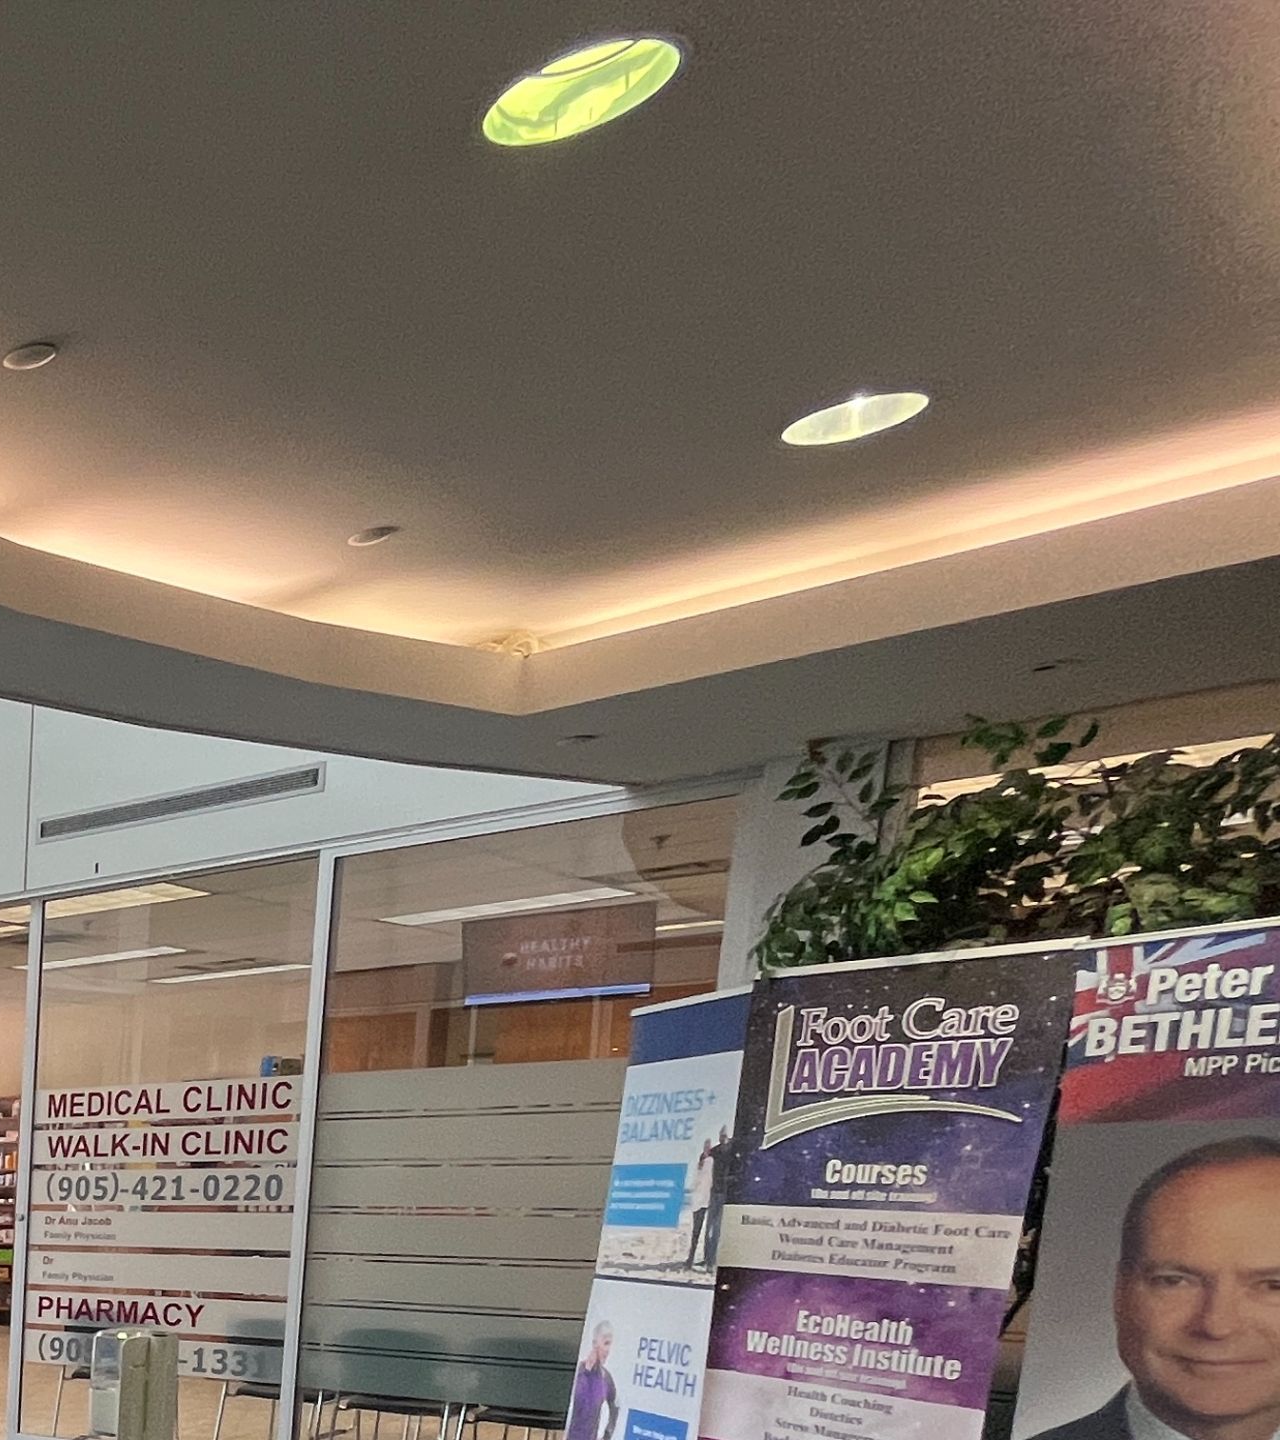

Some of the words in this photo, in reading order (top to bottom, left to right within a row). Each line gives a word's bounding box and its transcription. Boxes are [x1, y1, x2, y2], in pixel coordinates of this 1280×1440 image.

[520, 937, 590, 953] HEALTHY
[1146, 963, 1275, 1005] Peter
[796, 1006, 894, 1047] Foot
[902, 997, 1020, 1040] Care
[789, 1037, 1014, 1094] ACADEMY
[1184, 1054, 1239, 1077] MPP
[47, 1088, 170, 1118] MEDICAL
[183, 1081, 293, 1113] CLINIC
[625, 1088, 705, 1117] DIZZINESS
[47, 1133, 170, 1158] WALK-IN
[181, 1128, 289, 1156] CLINIC
[620, 1117, 695, 1144] BALANCE
[46, 1172, 283, 1202] (905)-421-0220
[825, 1159, 928, 1186] Courses
[778, 1218, 840, 1231] Advanced
[844, 1220, 867, 1232] and
[871, 1221, 928, 1236] Diabetic
[933, 1223, 969, 1237] Foot
[975, 1226, 1013, 1240] Care
[778, 1233, 823, 1246] Wound
[827, 1236, 857, 1249] Care
[862, 1239, 954, 1256] Management
[37, 1296, 205, 1328] PHARMACY
[796, 1310, 913, 1346] EcoHealth
[637, 1336, 692, 1368] PELVIC
[746, 1330, 848, 1366] Wellness
[852, 1343, 962, 1380] Institute
[632, 1363, 697, 1398] HEALTH
[787, 1386, 827, 1402] Health
